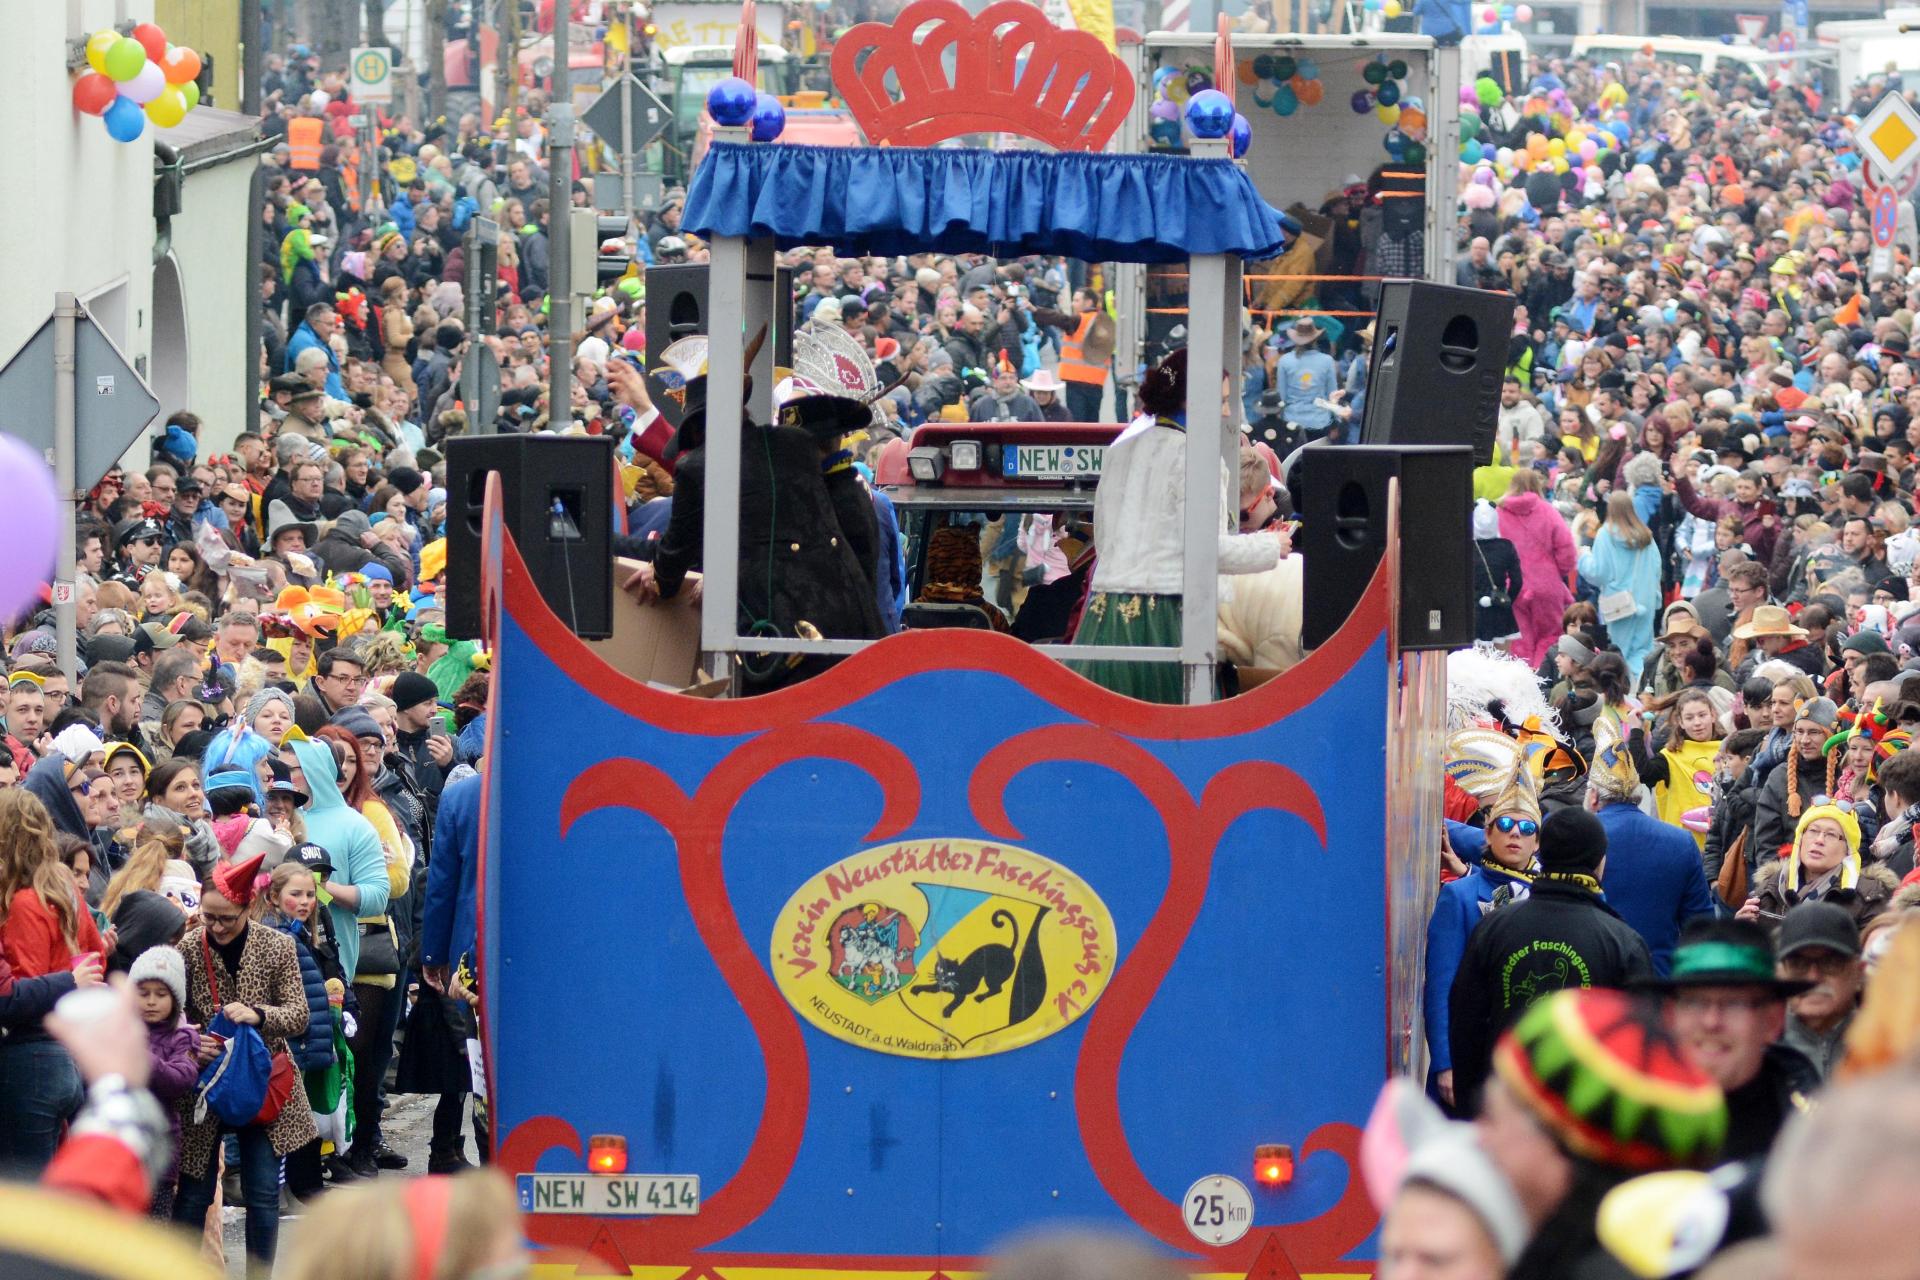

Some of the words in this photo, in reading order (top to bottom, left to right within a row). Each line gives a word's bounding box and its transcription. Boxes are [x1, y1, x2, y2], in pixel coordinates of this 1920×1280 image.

[1019, 448, 1060, 472] NEW
[1076, 448, 1103, 472] SW
[301, 845, 322, 860] SWAT
[787, 897, 831, 979] Verein
[825, 843, 973, 901] Neustädter
[975, 846, 1102, 975] Faschingszug
[1532, 940, 1592, 991] Faschingszug
[809, 994, 873, 1039] NEUSTADT
[895, 1036, 958, 1052] Waldnaab
[534, 1180, 586, 1208] NEW
[606, 1180, 638, 1208] SW
[646, 1181, 697, 1209] 414
[1193, 1194, 1224, 1227] 25
[1228, 1202, 1247, 1222] km
